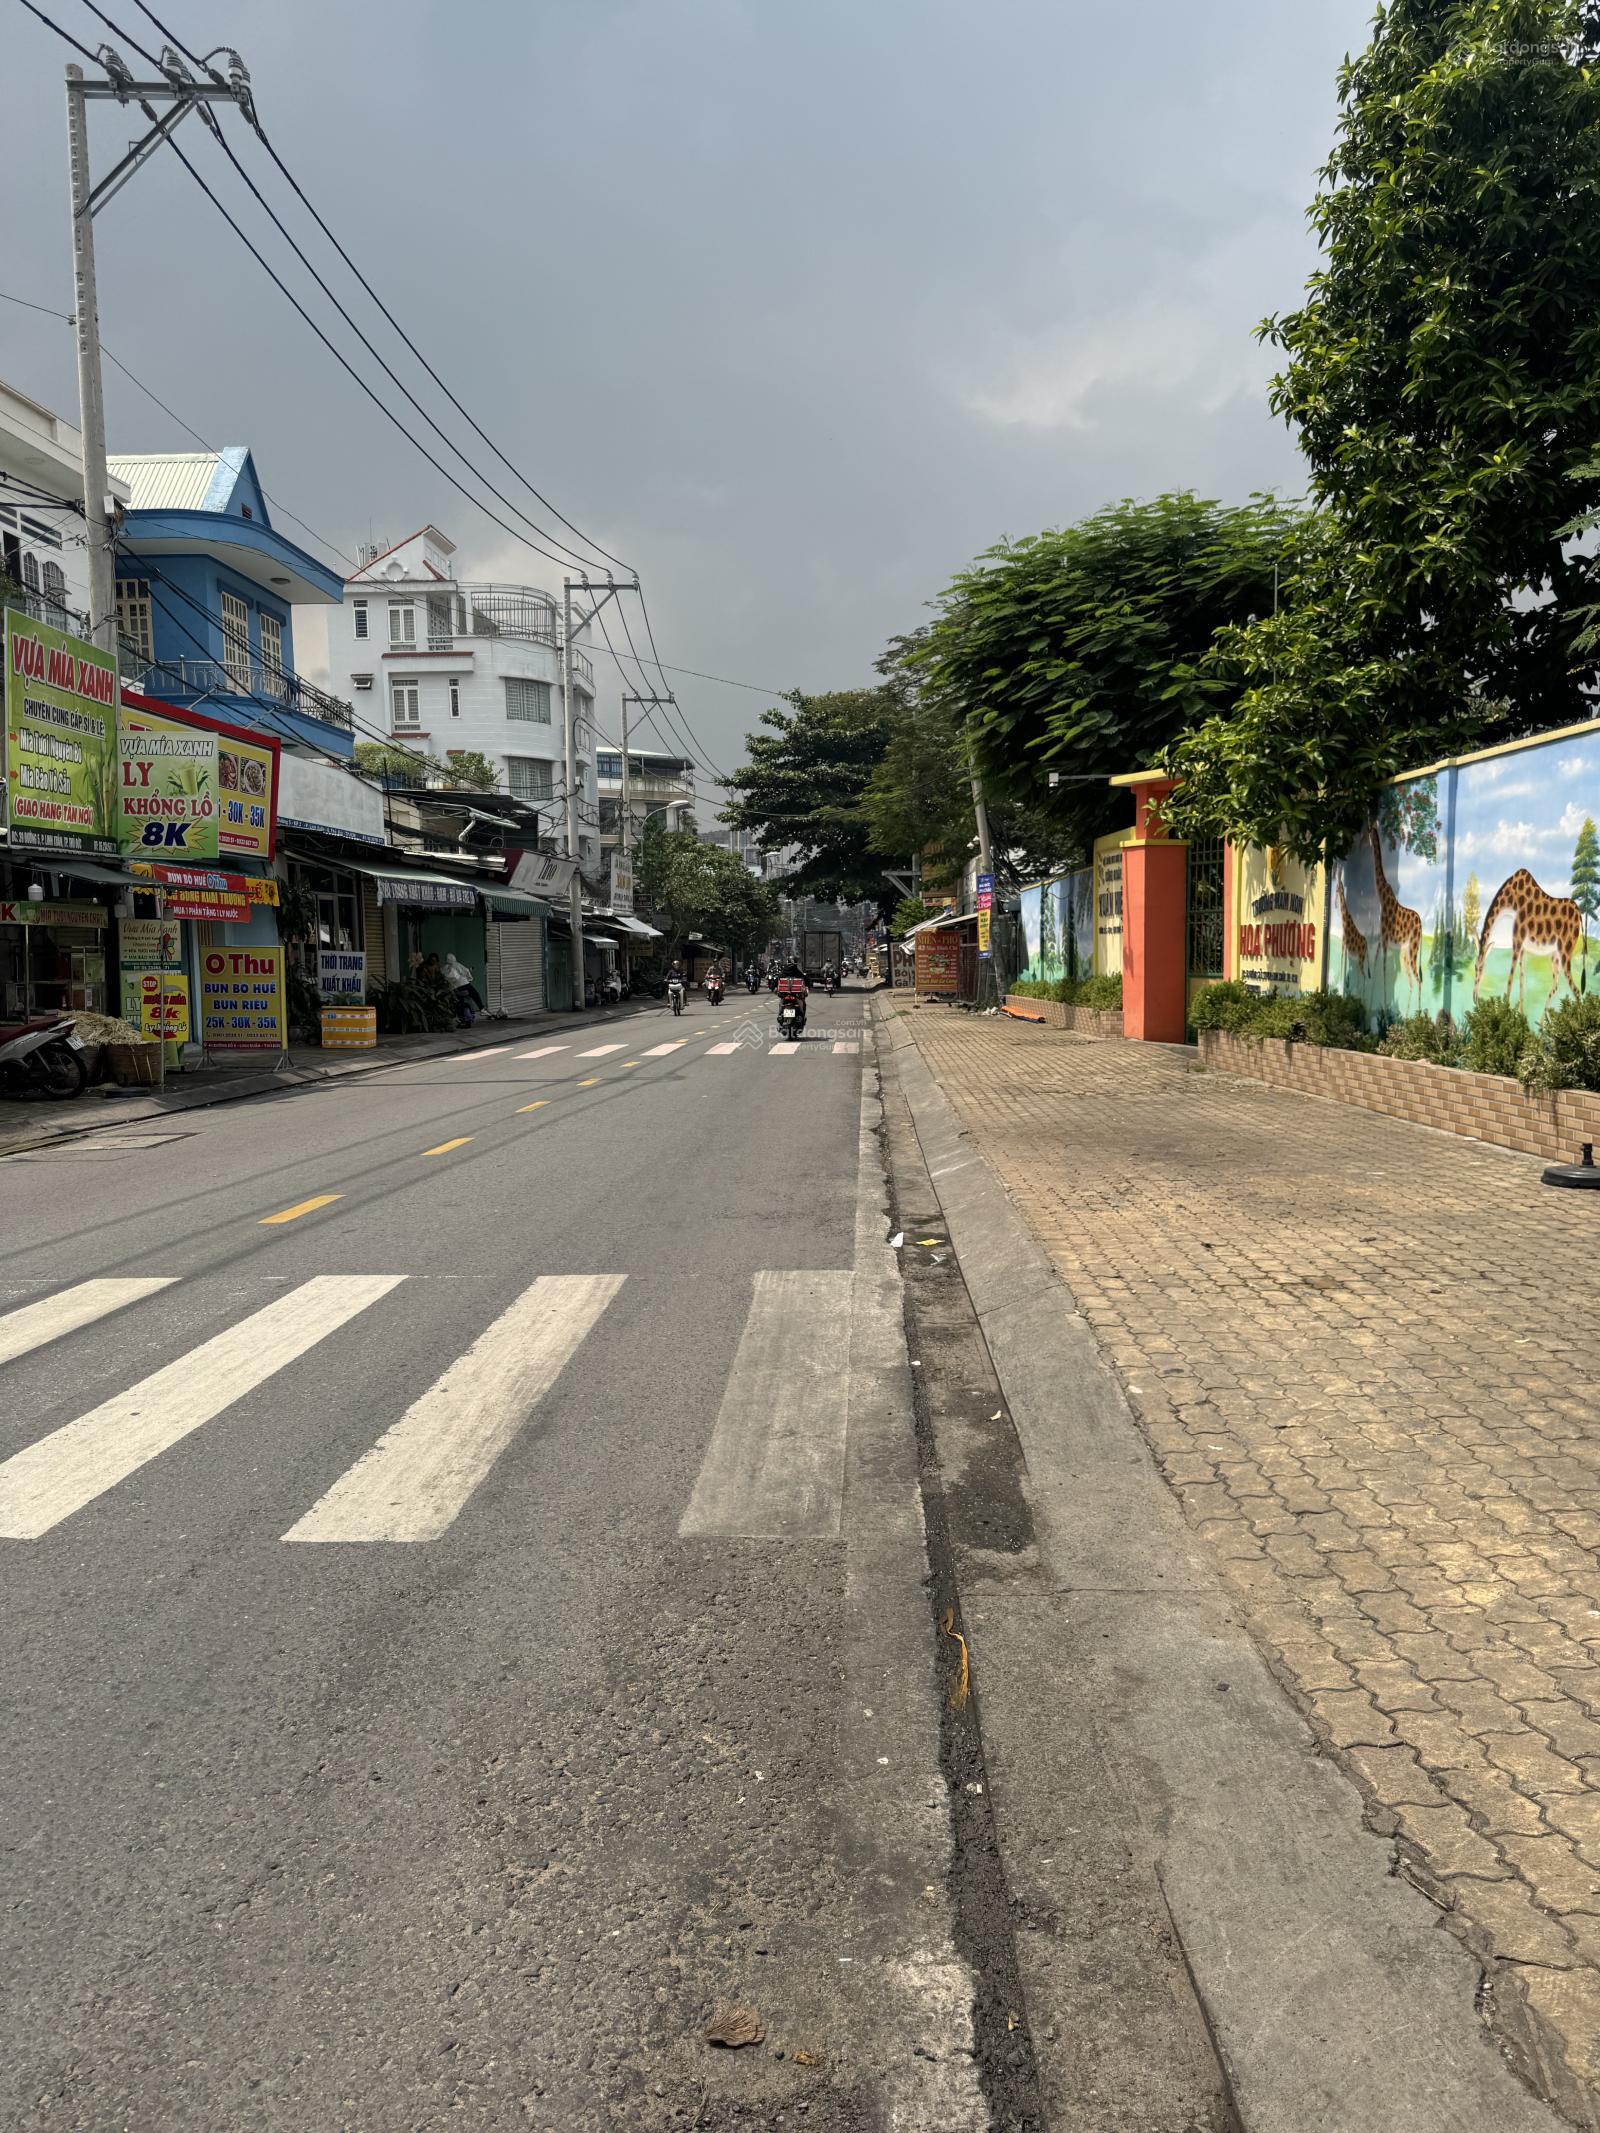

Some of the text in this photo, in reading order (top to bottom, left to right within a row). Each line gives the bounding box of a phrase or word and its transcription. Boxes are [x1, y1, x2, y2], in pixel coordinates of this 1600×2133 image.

[12, 632, 115, 707] VỰA MÍA XANH
[24, 698, 51, 720] CHUYÊN
[52, 706, 69, 725] CUNG
[120, 735, 214, 759] VỰA MÍA XANH
[122, 761, 154, 787] LY
[123, 789, 213, 817] KHỔNG LỒ
[228, 800, 244, 824] 30K
[250, 806, 265, 829] 35K
[141, 822, 192, 847] 8K
[1240, 919, 1316, 965] HOA PHƯỢNG
[206, 953, 275, 975] O Thu
[339, 955, 363, 970] TRANG
[143, 980, 157, 988] STOP
[322, 973, 362, 992] XUẤT KHẨU
[206, 1016, 225, 1029] 25K
[231, 1016, 251, 1029] 30K
[257, 1016, 277, 1029] 35K
